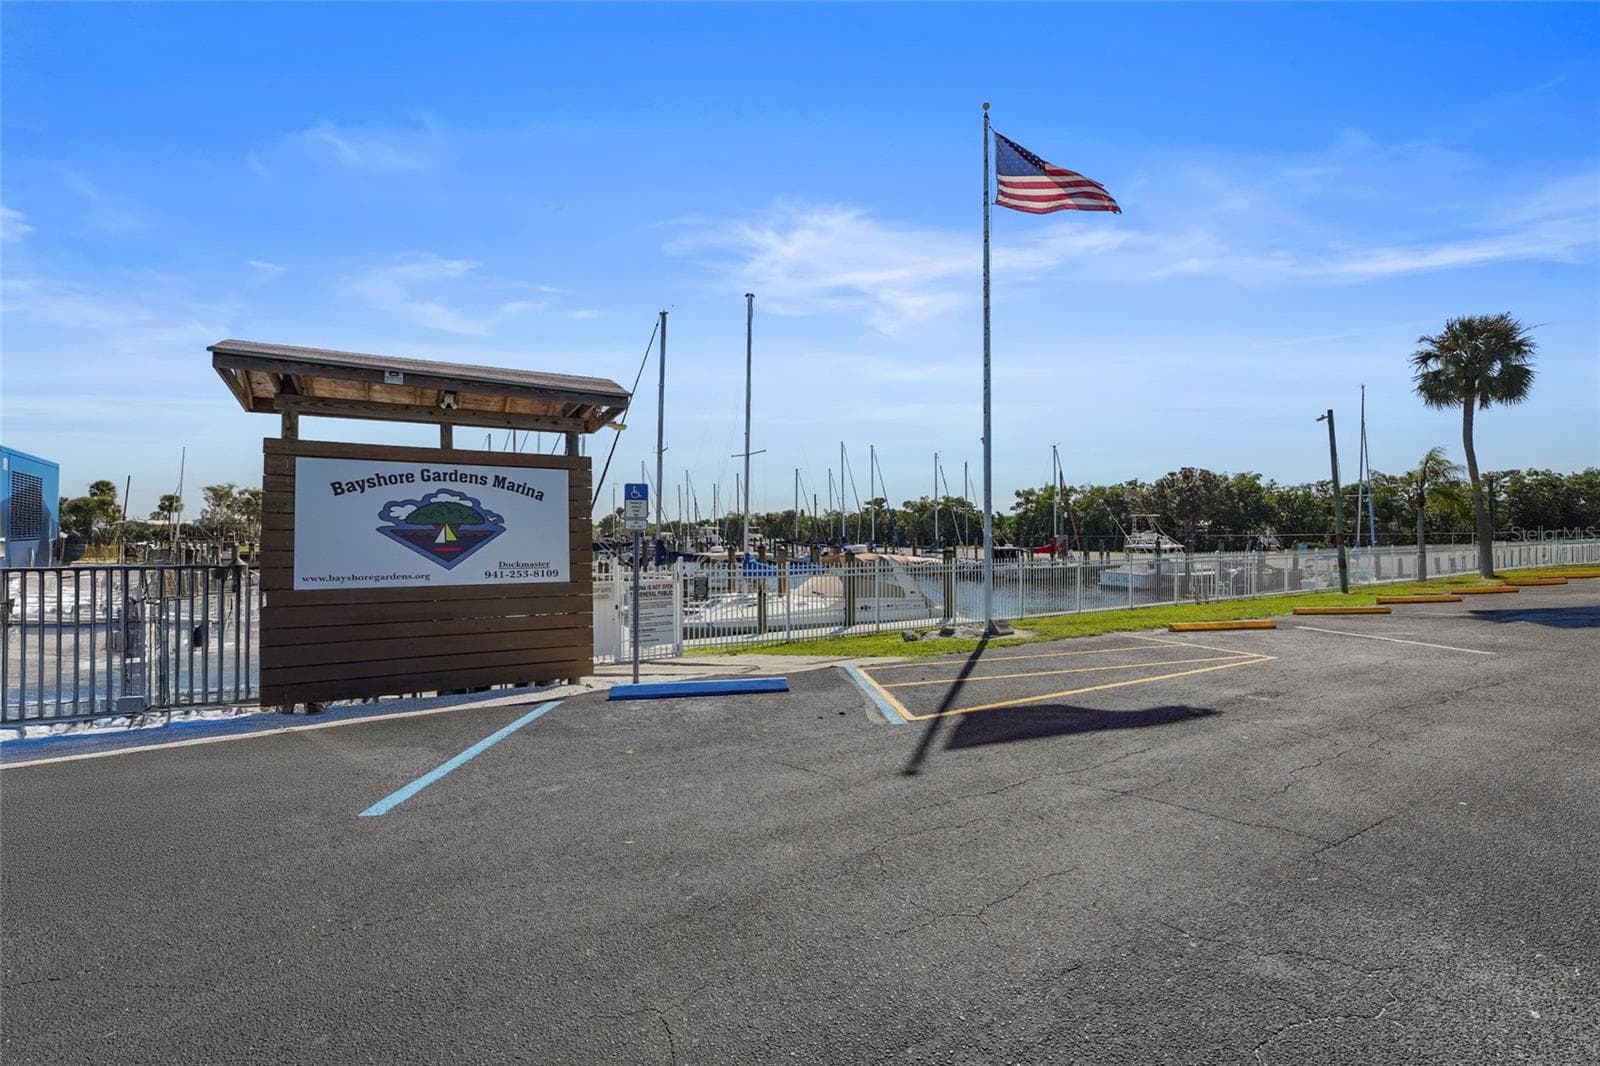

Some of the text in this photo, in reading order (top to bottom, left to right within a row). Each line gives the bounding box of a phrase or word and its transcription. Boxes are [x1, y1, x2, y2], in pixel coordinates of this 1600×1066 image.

[330, 468, 545, 501] Bayshore Gardens Marina
[301, 573, 431, 583] www.bayshoregardens.org
[484, 569, 559, 579] 941-253-8109
